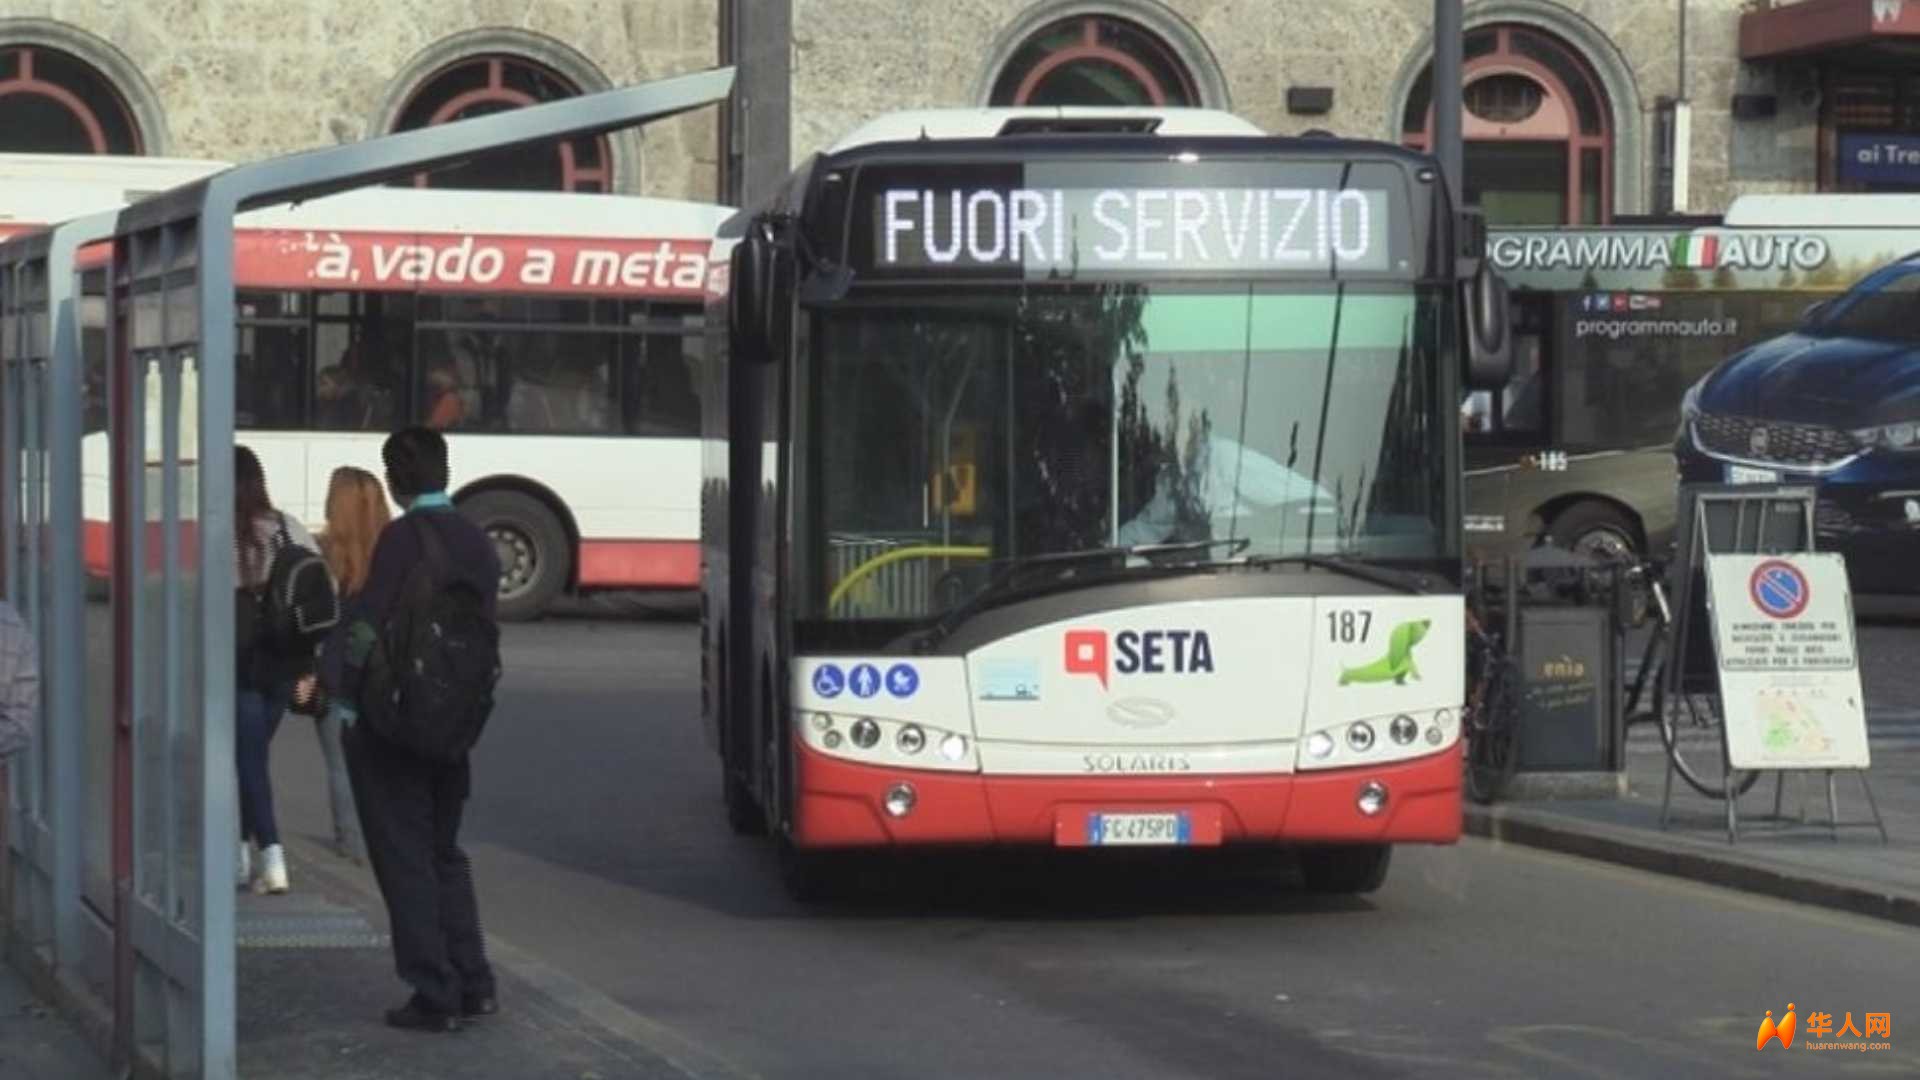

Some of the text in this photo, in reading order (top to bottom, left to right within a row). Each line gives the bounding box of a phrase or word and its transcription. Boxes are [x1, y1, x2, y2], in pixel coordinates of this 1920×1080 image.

[886, 188, 1370, 263] FUORI SERVIZIO
[372, 237, 504, 283] vado
[519, 246, 554, 285] a
[1719, 235, 1829, 269] AUTO
[1576, 318, 1738, 339] programmauto.it
[1327, 610, 1373, 643] 187
[1114, 629, 1215, 674] SETA
[1082, 755, 1191, 772] SOLARIS
